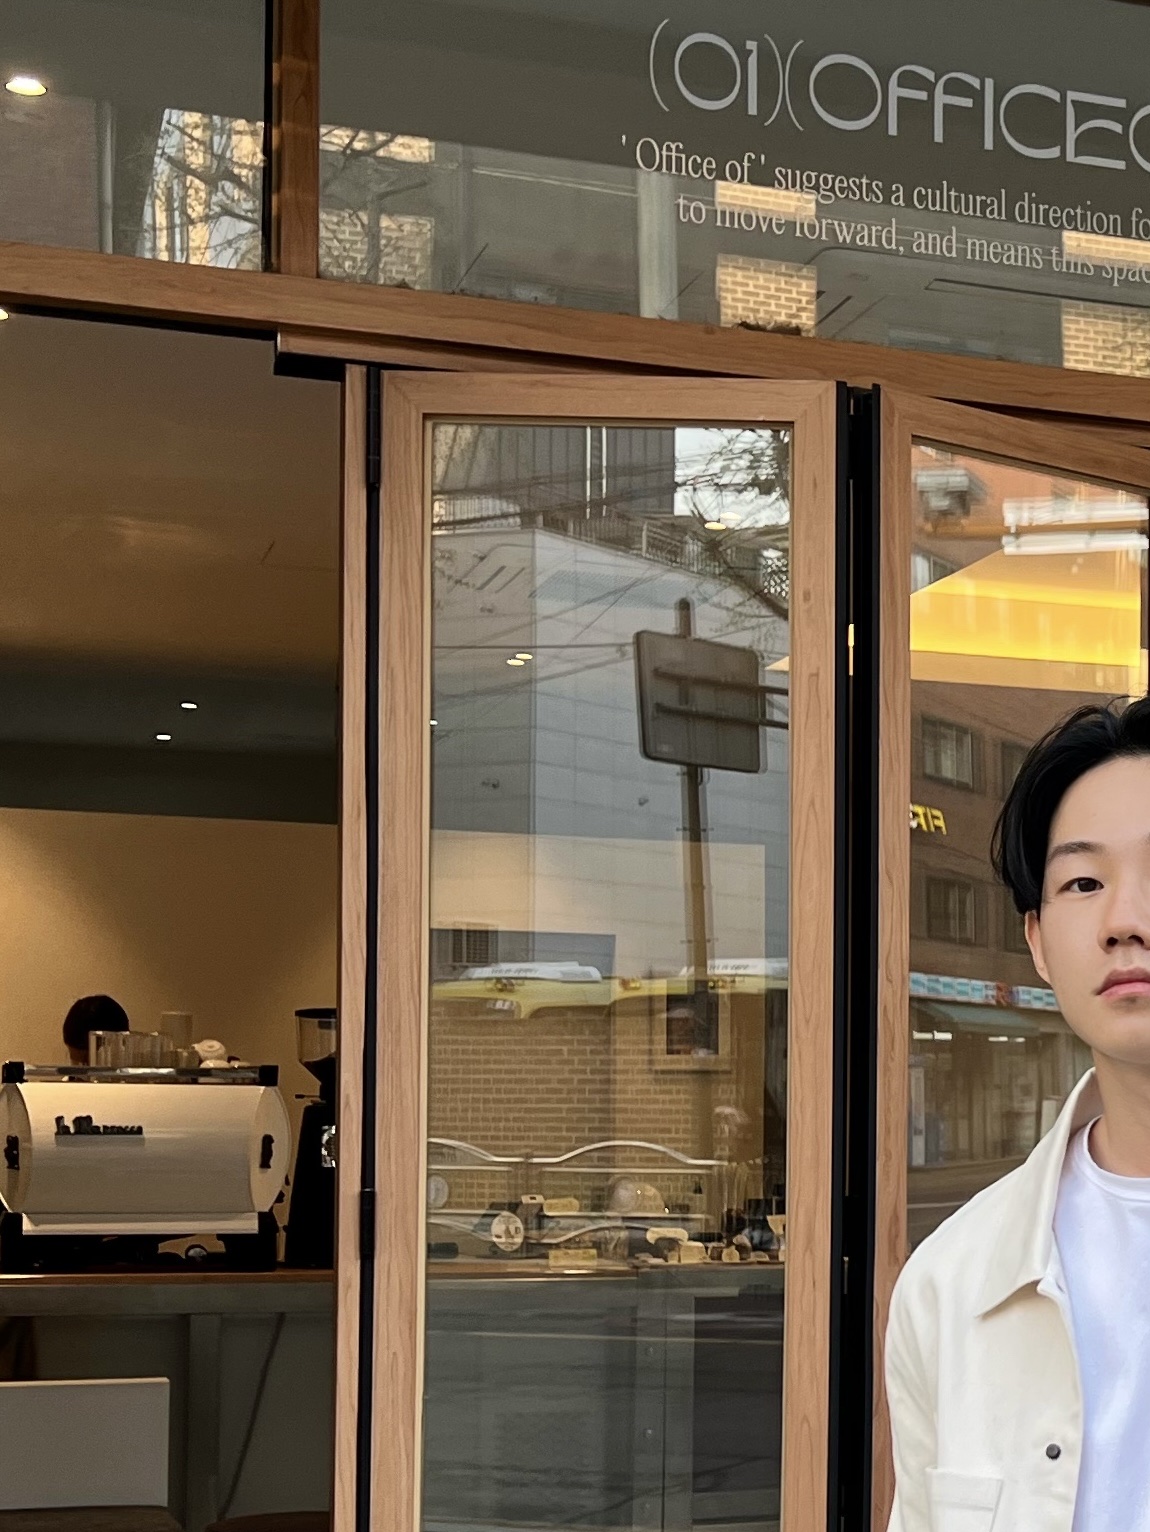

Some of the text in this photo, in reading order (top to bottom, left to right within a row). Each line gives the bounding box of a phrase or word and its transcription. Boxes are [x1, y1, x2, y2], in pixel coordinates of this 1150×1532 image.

[677, 194, 706, 224] to
[716, 204, 785, 235] move
[795, 207, 904, 255] forward,
[912, 226, 957, 257] and
[966, 235, 1043, 269] means
[1050, 243, 1094, 276] this
[774, 165, 883, 204] suggests
[890, 183, 905, 207] a
[913, 180, 1007, 220] cultural
[1015, 191, 1121, 236] direction
